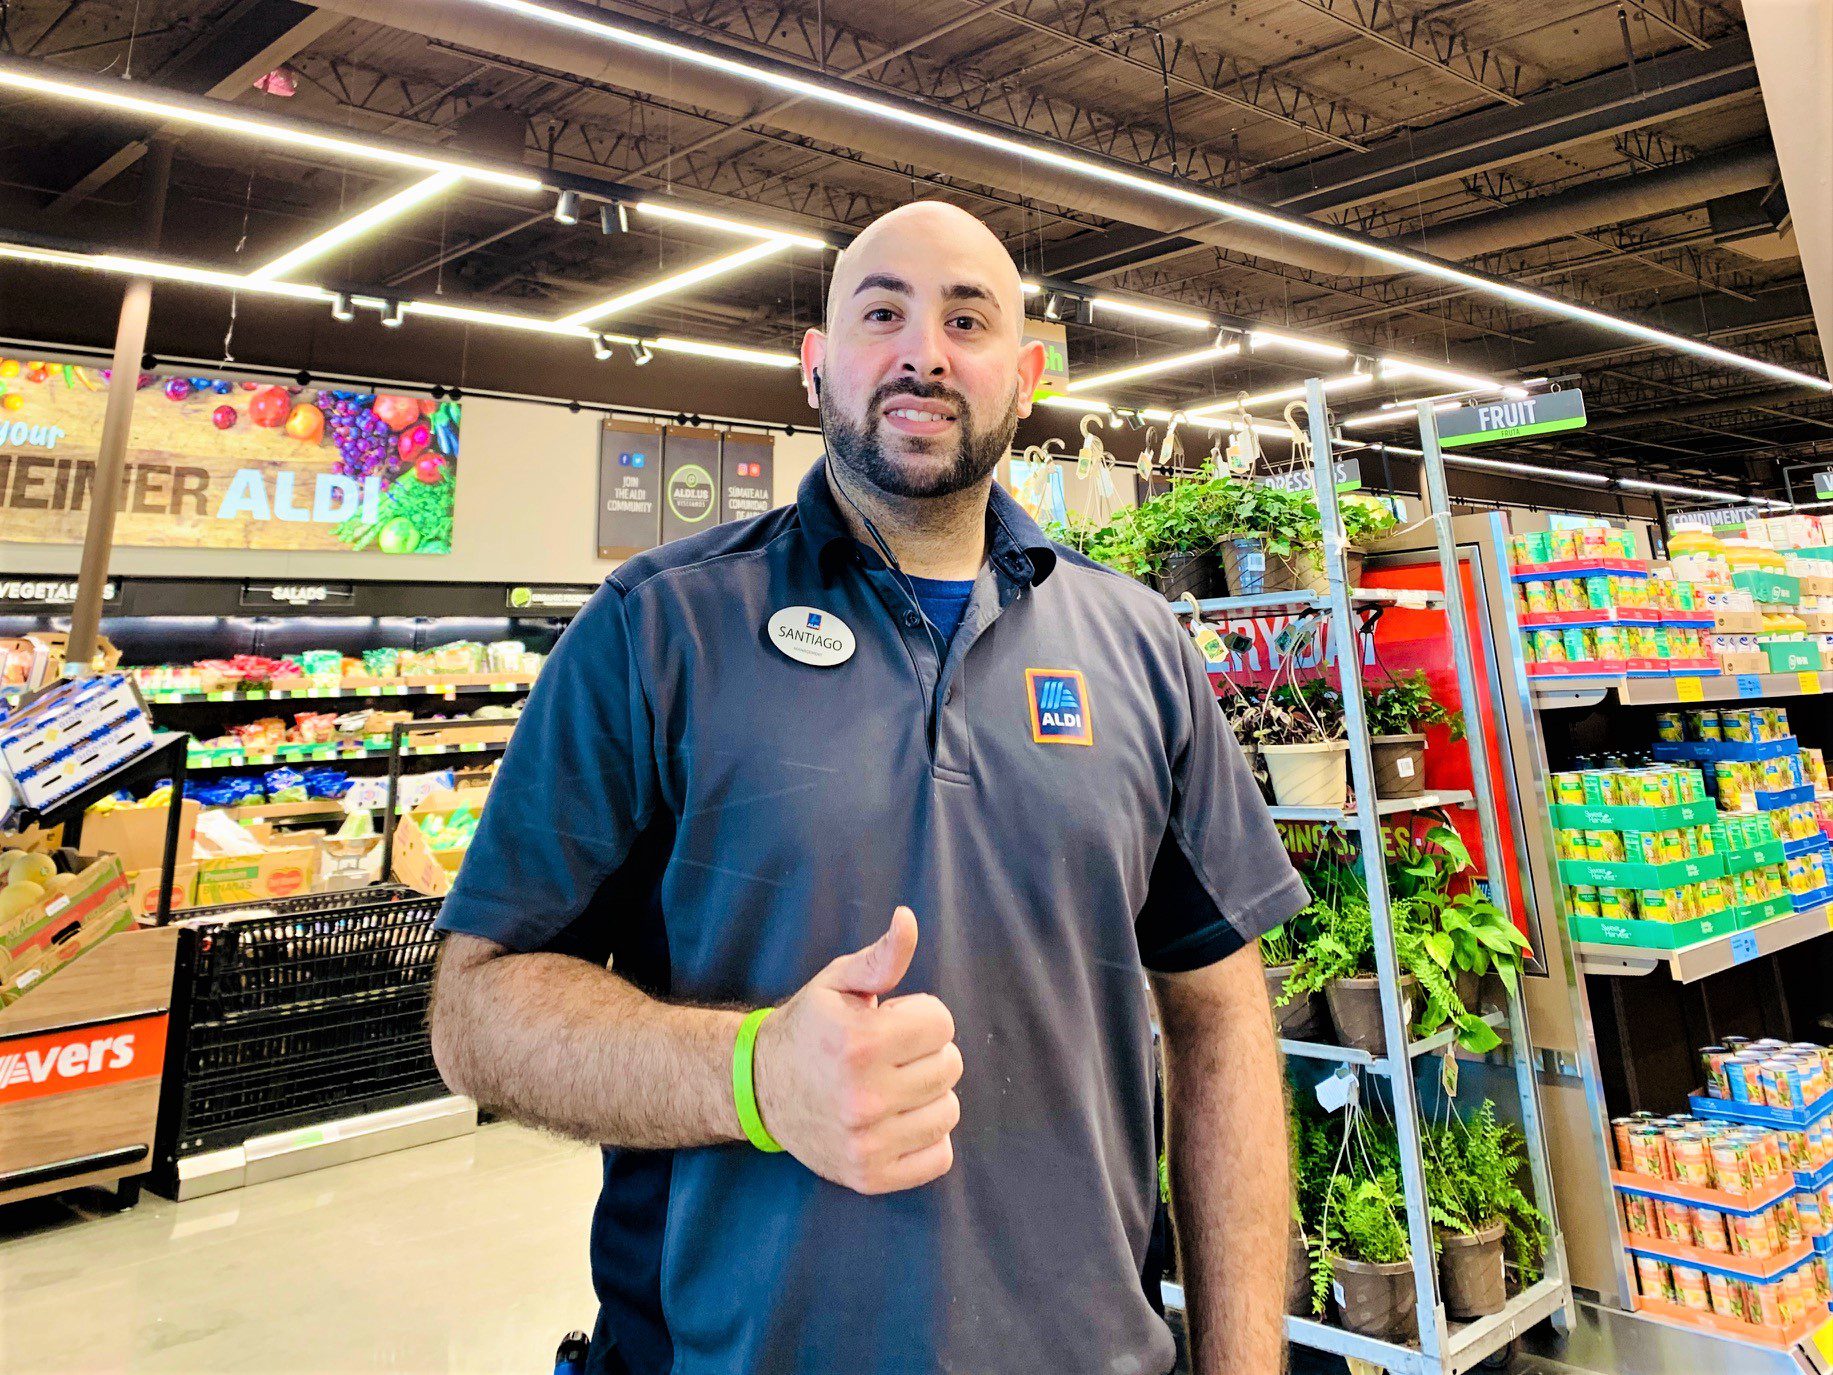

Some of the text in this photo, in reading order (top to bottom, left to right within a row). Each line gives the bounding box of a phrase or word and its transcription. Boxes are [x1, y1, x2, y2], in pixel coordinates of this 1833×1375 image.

[1478, 400, 1537, 431] FRUIT
[1501, 428, 1521, 438] FRUTA
[622, 476, 639, 488] JOIN
[217, 468, 382, 524] ALDI
[614, 488, 646, 500] THE ALDI
[607, 500, 652, 513] COMMUNITY
[1671, 508, 1757, 528] CONDIMENTS
[779, 625, 843, 651] SANTIAGO
[1041, 712, 1082, 729] ALDI
